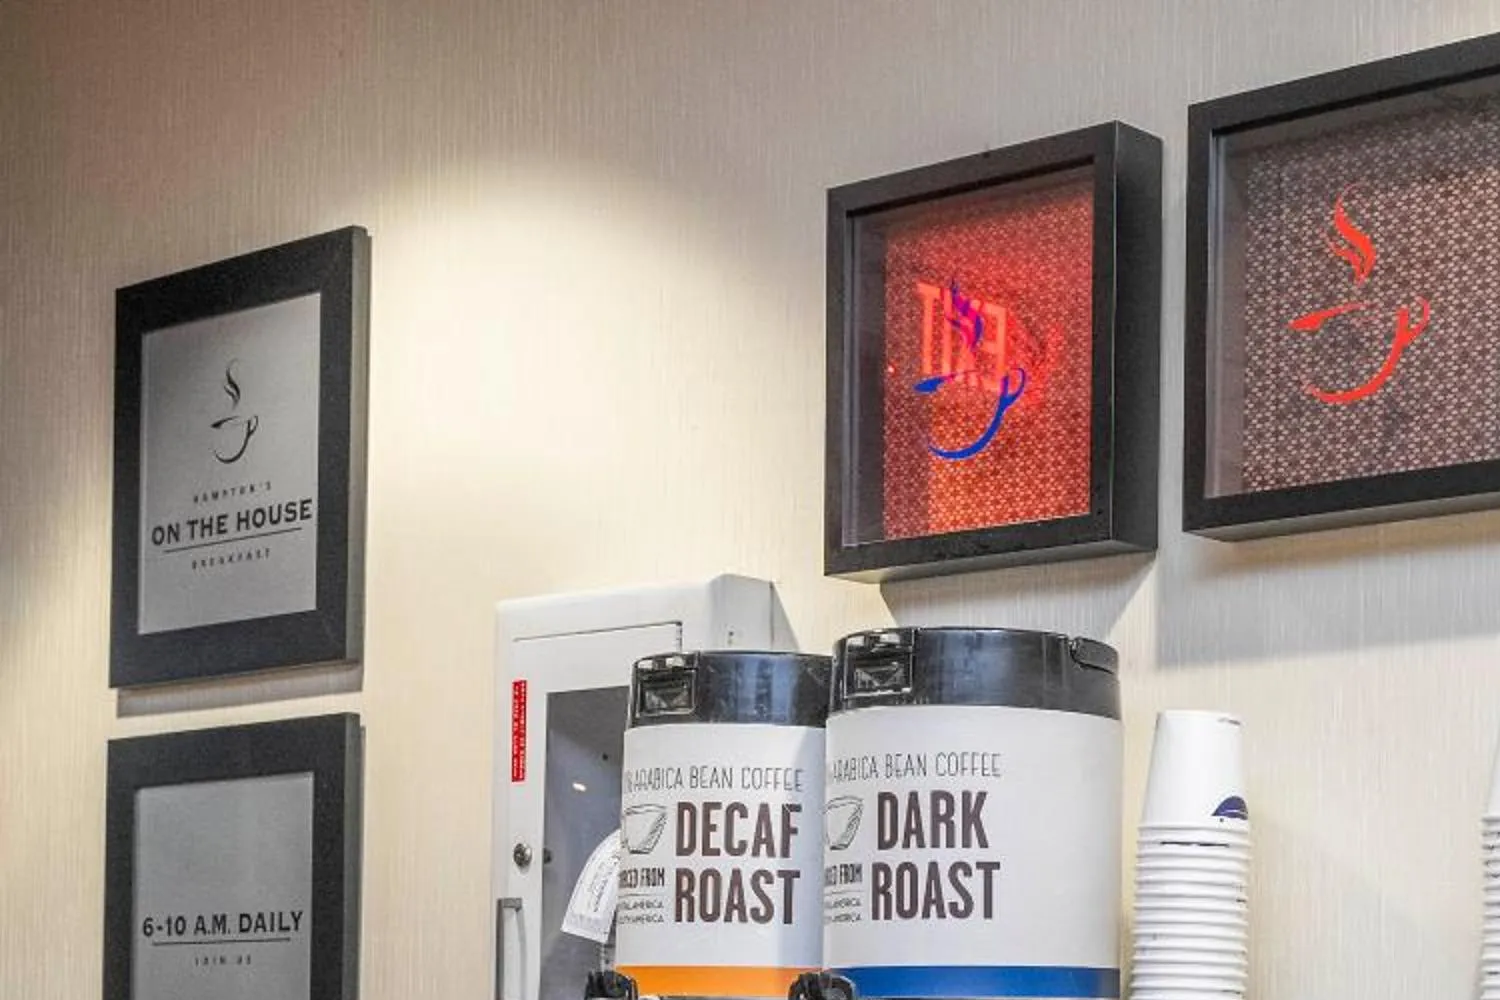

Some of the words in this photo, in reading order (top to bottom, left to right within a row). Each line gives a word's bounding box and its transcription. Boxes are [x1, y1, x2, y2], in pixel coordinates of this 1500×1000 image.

[152, 523, 180, 546] ON
[186, 514, 229, 540] THE
[236, 499, 313, 533] HOUSE
[689, 765, 734, 790] BEAN
[740, 766, 805, 793] COFFEE
[885, 753, 928, 779] BEAN
[935, 751, 1003, 777] COFFEE
[675, 801, 803, 859] DECAF
[876, 789, 989, 851] DARK
[673, 866, 802, 926] ROAST
[871, 860, 1001, 922] ROAST
[143, 917, 187, 937] 6-10
[194, 914, 231, 935] A.M.
[239, 910, 304, 933] DAILY
